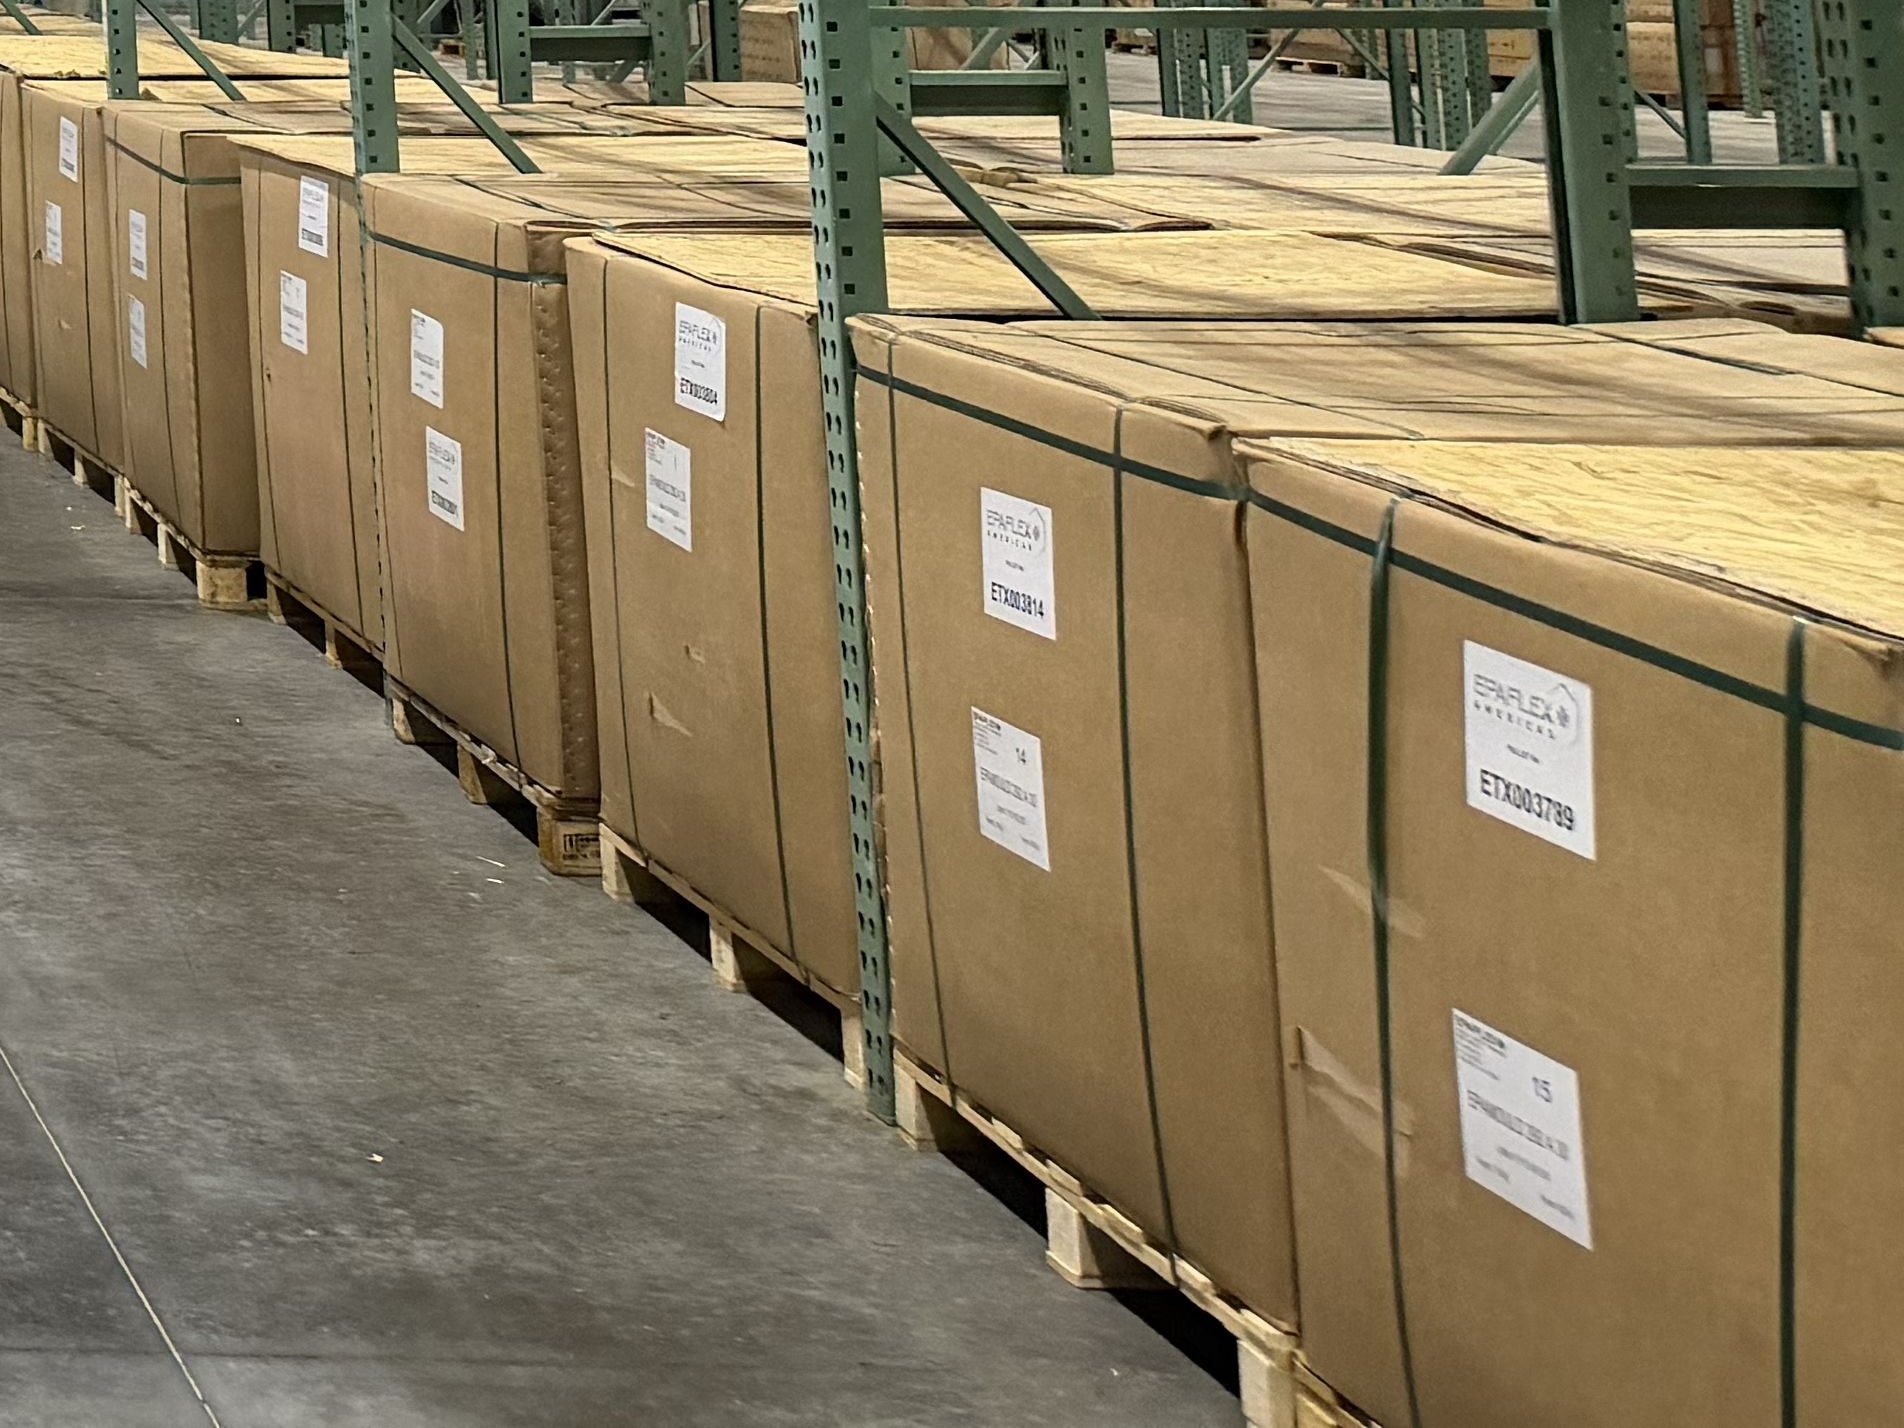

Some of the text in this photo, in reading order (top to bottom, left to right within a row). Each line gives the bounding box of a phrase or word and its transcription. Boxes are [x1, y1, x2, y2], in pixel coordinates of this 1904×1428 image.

[991, 581, 1045, 620] ETX003814
[1472, 673, 1556, 725] EPAFLEX
[1479, 767, 1575, 832] ETX003789
[1531, 1076, 1553, 1104] 15
